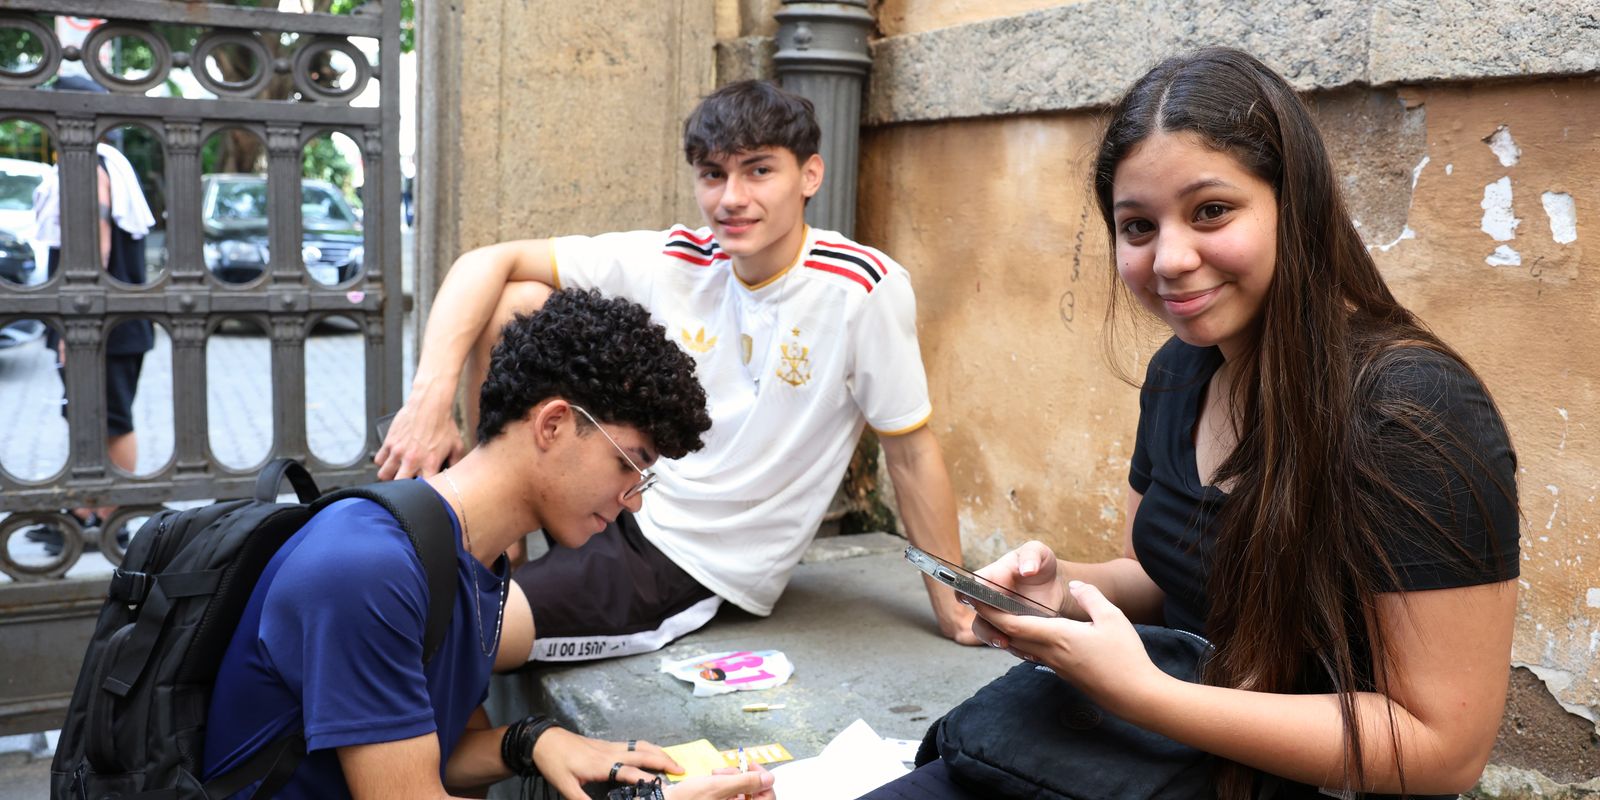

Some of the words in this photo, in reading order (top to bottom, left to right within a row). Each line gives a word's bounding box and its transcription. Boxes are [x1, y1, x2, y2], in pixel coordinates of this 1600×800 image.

[546, 642, 557, 657] IT
[560, 643, 575, 657] DO
[578, 640, 607, 657] JUST
